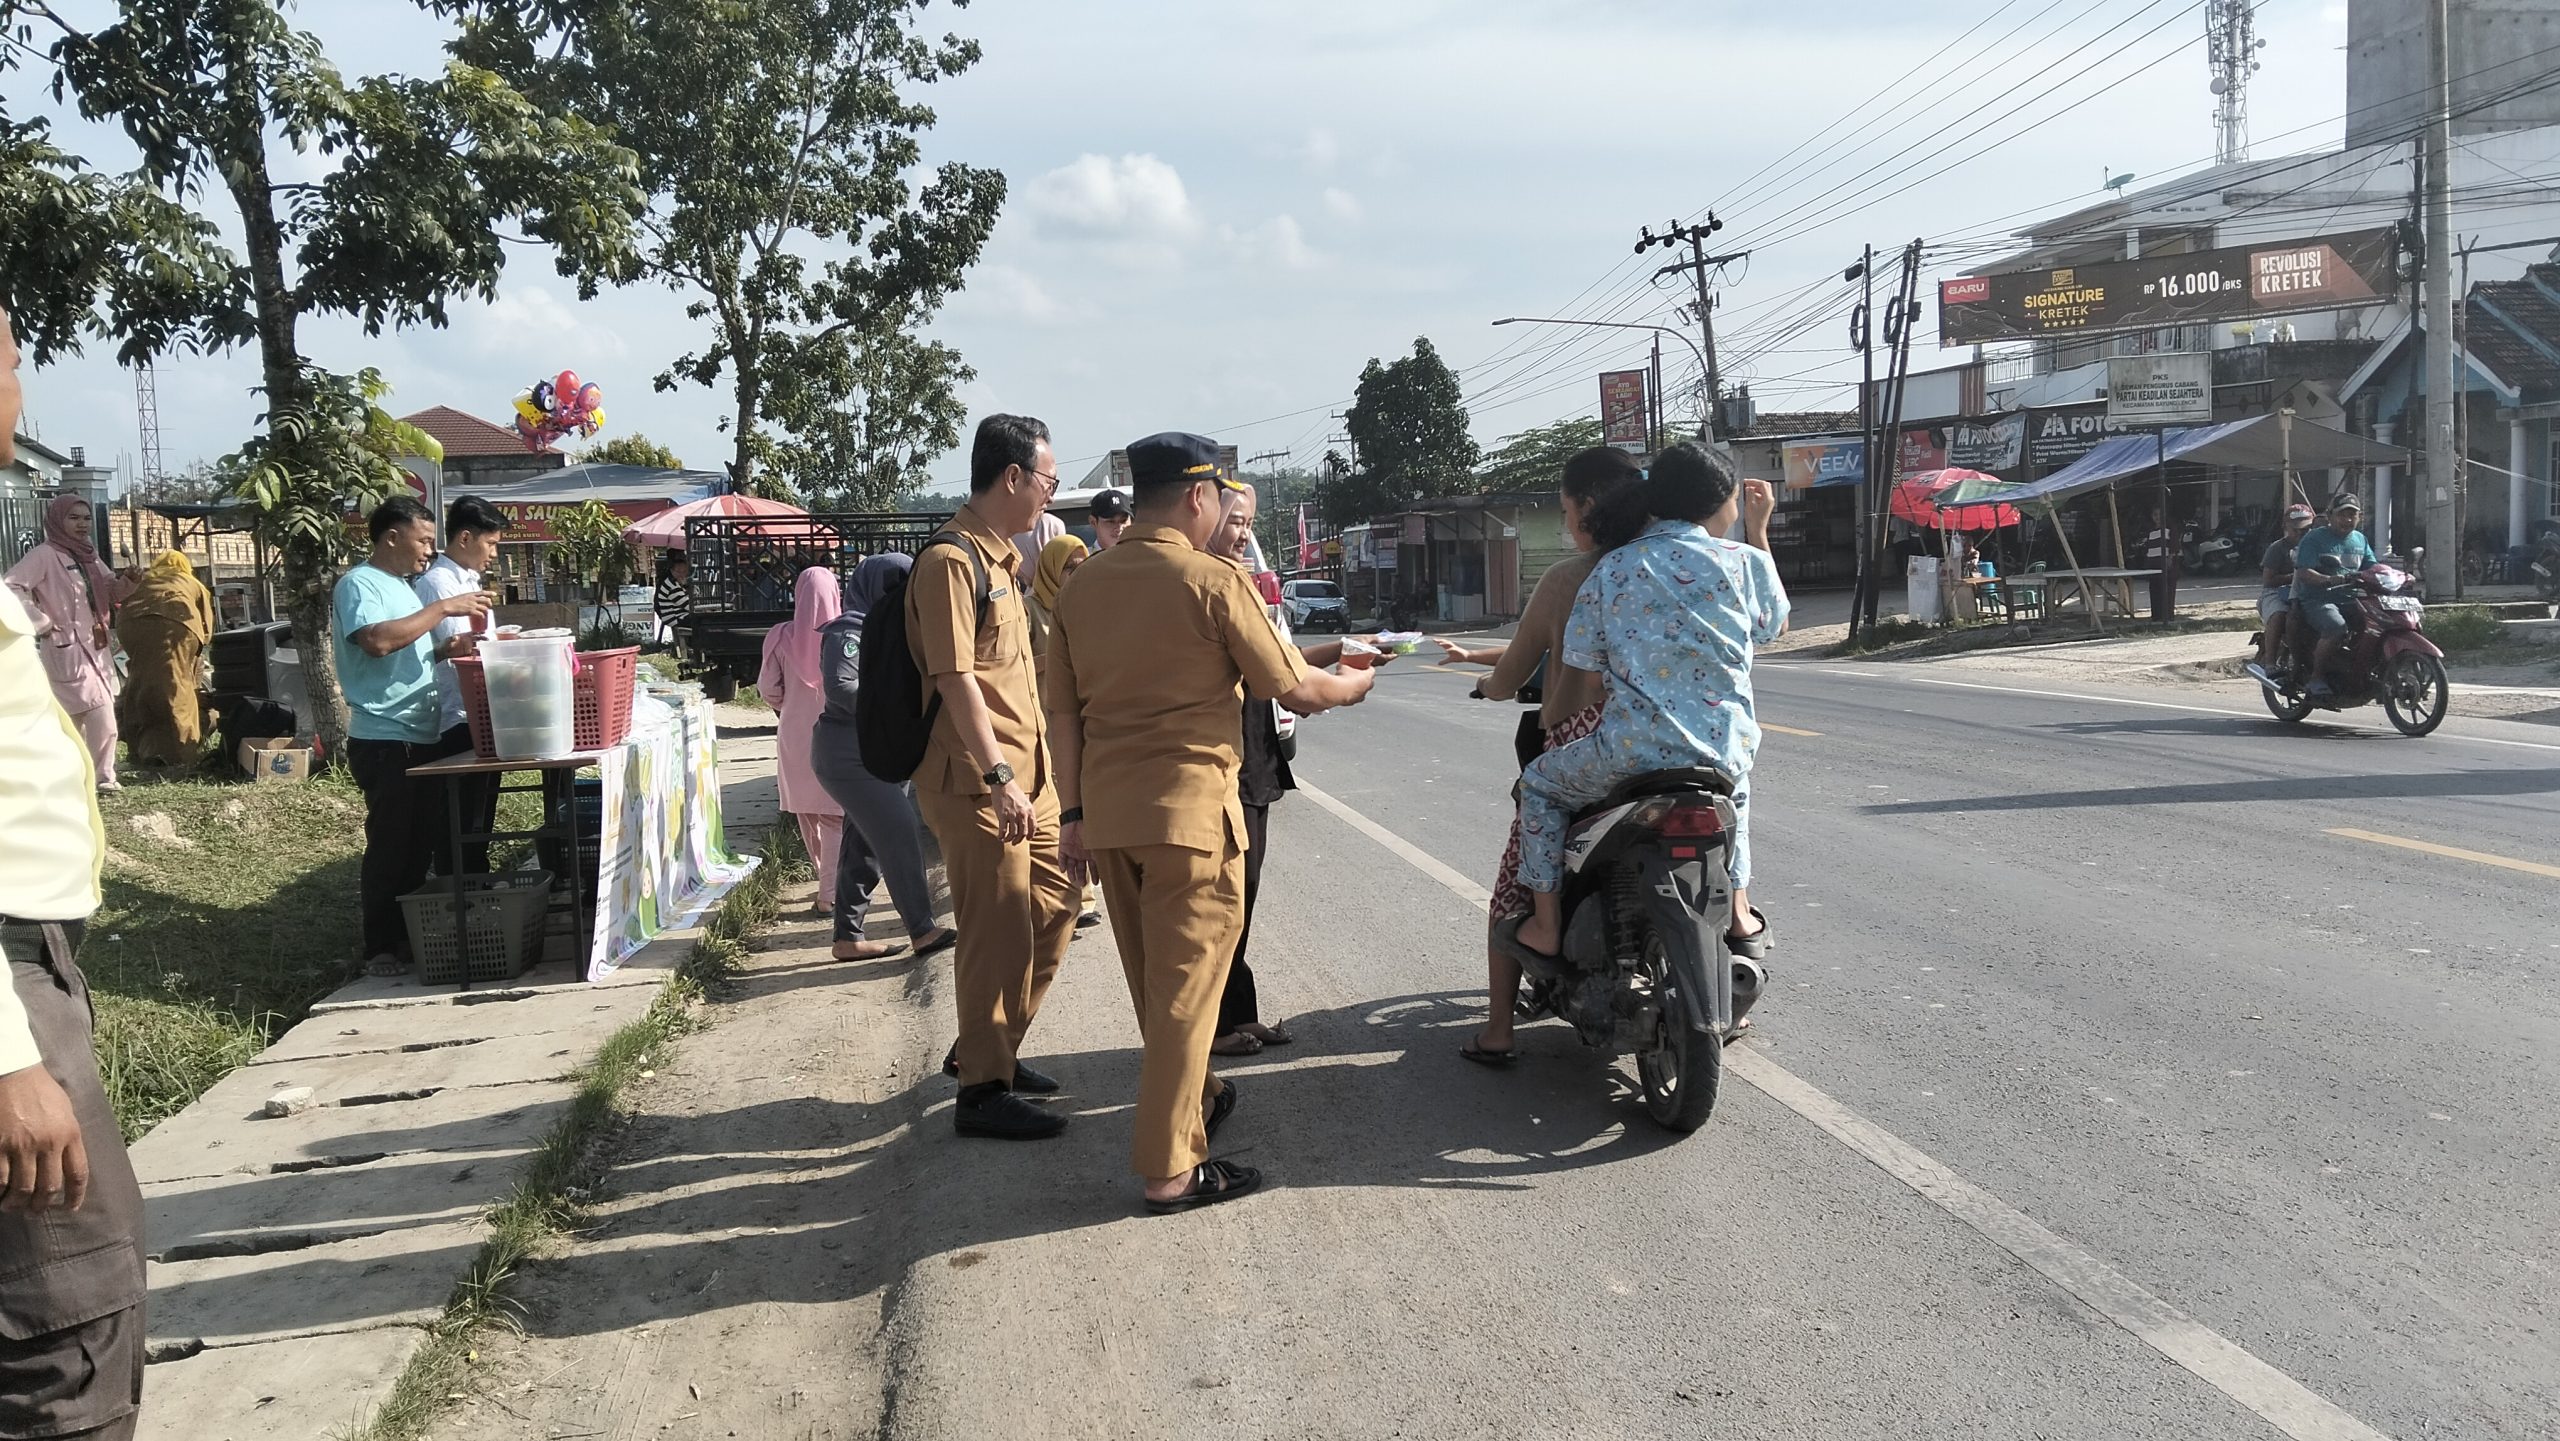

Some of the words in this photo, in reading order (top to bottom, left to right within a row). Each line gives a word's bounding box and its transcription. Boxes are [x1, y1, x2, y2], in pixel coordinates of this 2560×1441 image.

[2261, 250, 2321, 274] REVOLUSI
[1948, 282, 1985, 296] BARU
[2159, 271, 2220, 298] 16.000
[2261, 270, 2322, 294] KRETEK
[2024, 288, 2105, 308] SIGNATURE
[2039, 305, 2089, 320] KRETEK
[2143, 382, 2174, 390] PENGURUS
[2174, 380, 2199, 388] CABANG
[2116, 390, 2138, 402] PARTAI
[2138, 389, 2168, 401] KEADILAN
[2169, 388, 2204, 400] SEJAHTERA
[2122, 401, 2155, 409] KECAMATAN
